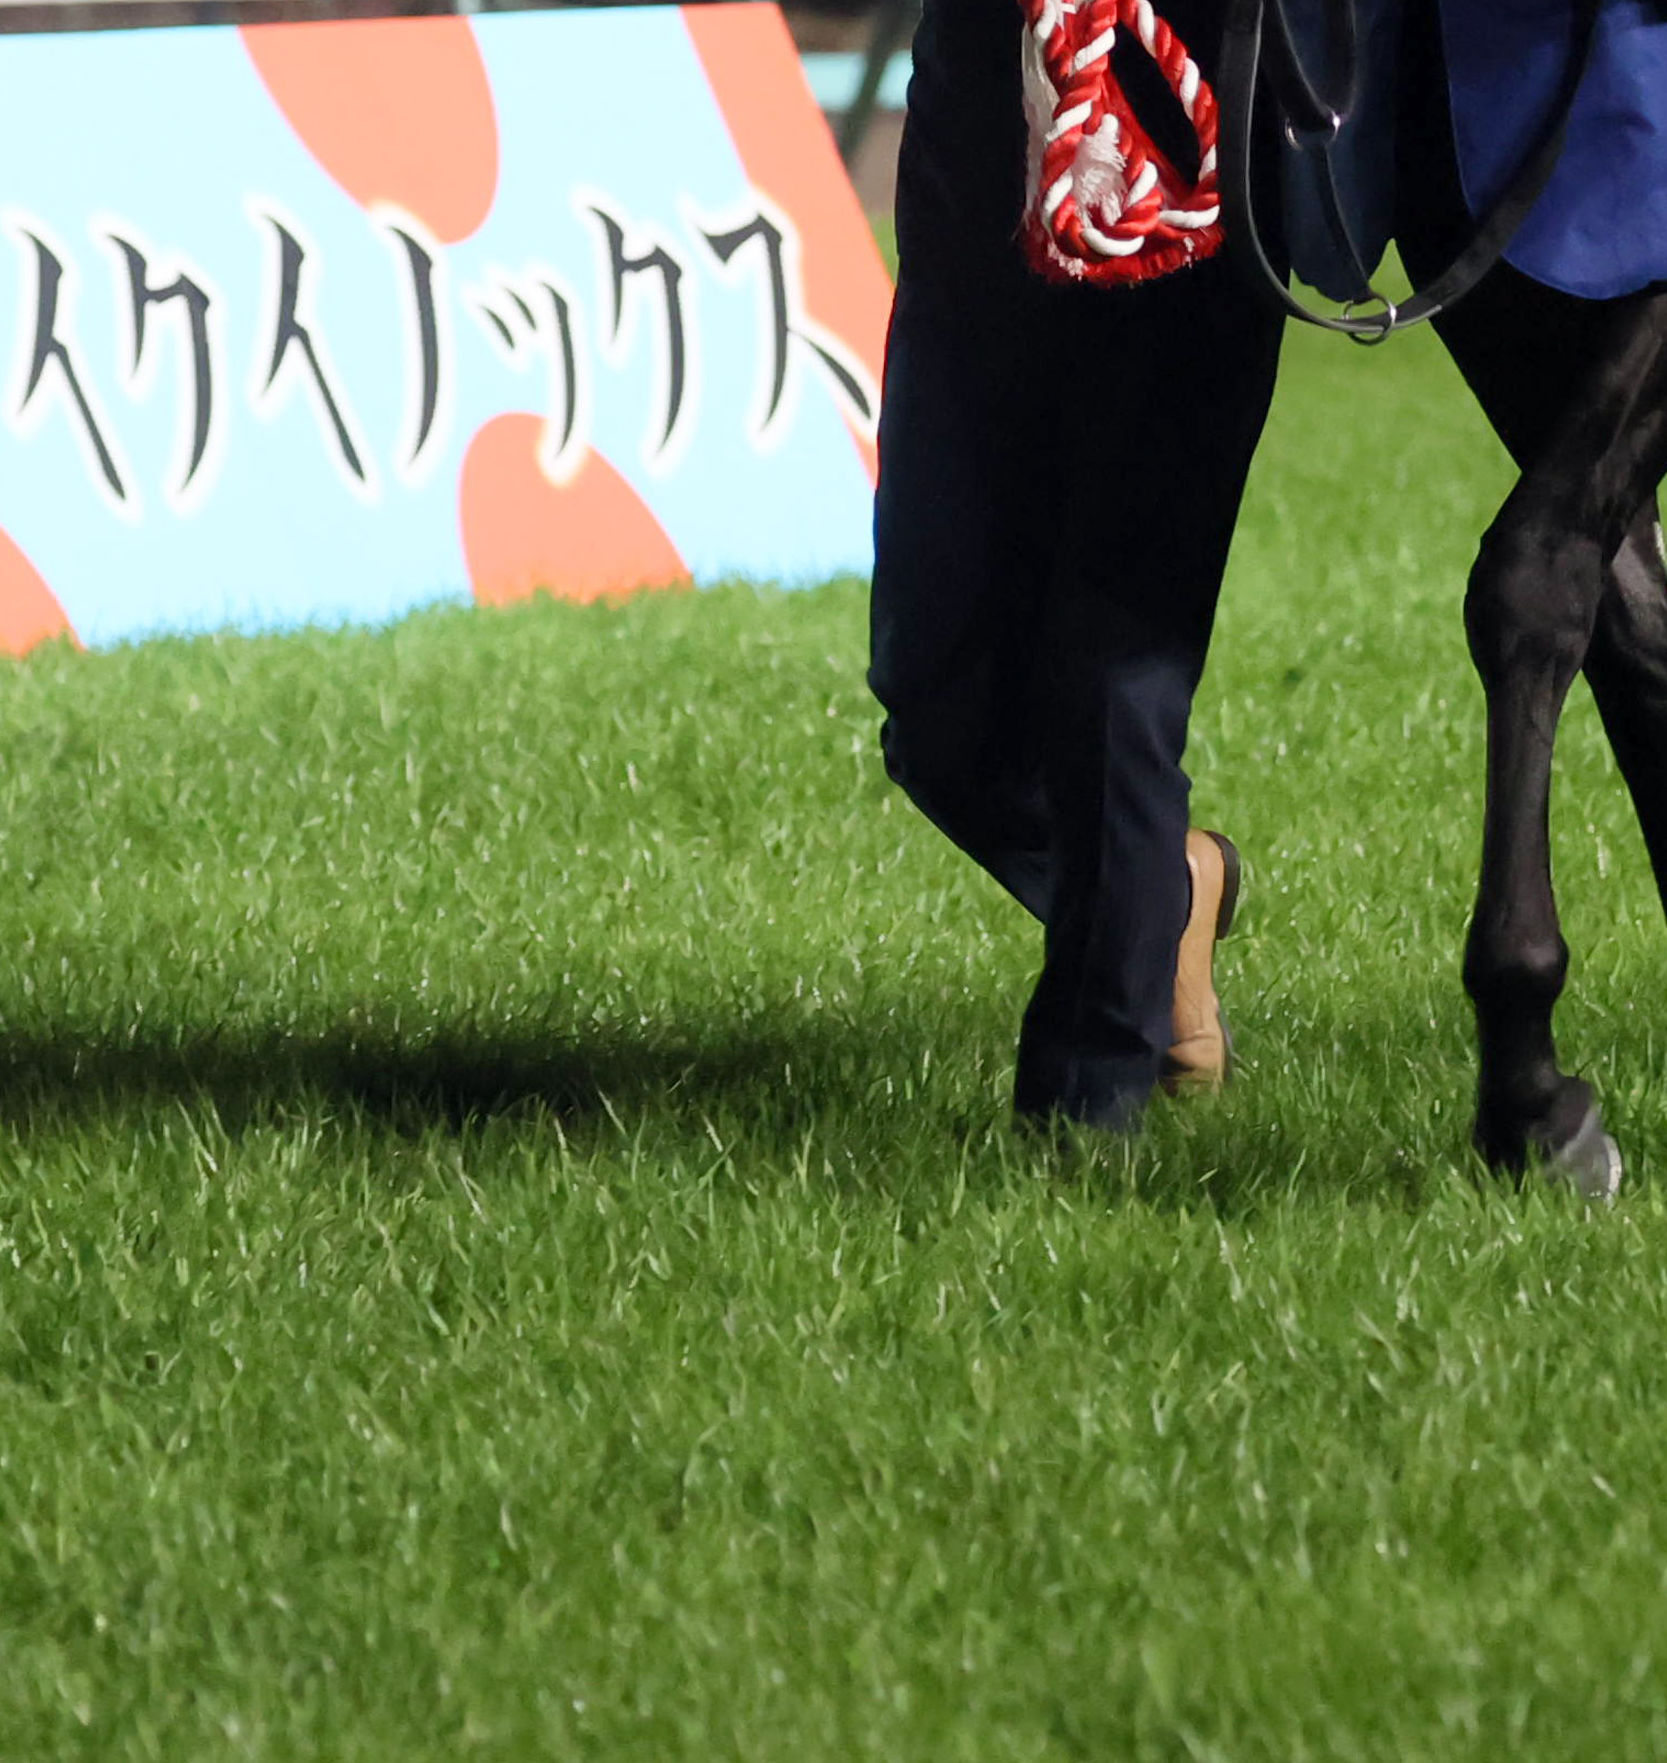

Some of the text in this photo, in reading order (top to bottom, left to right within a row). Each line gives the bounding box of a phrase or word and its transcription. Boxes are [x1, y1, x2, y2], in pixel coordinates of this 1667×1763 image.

[18, 205, 872, 501] イクイノックス
